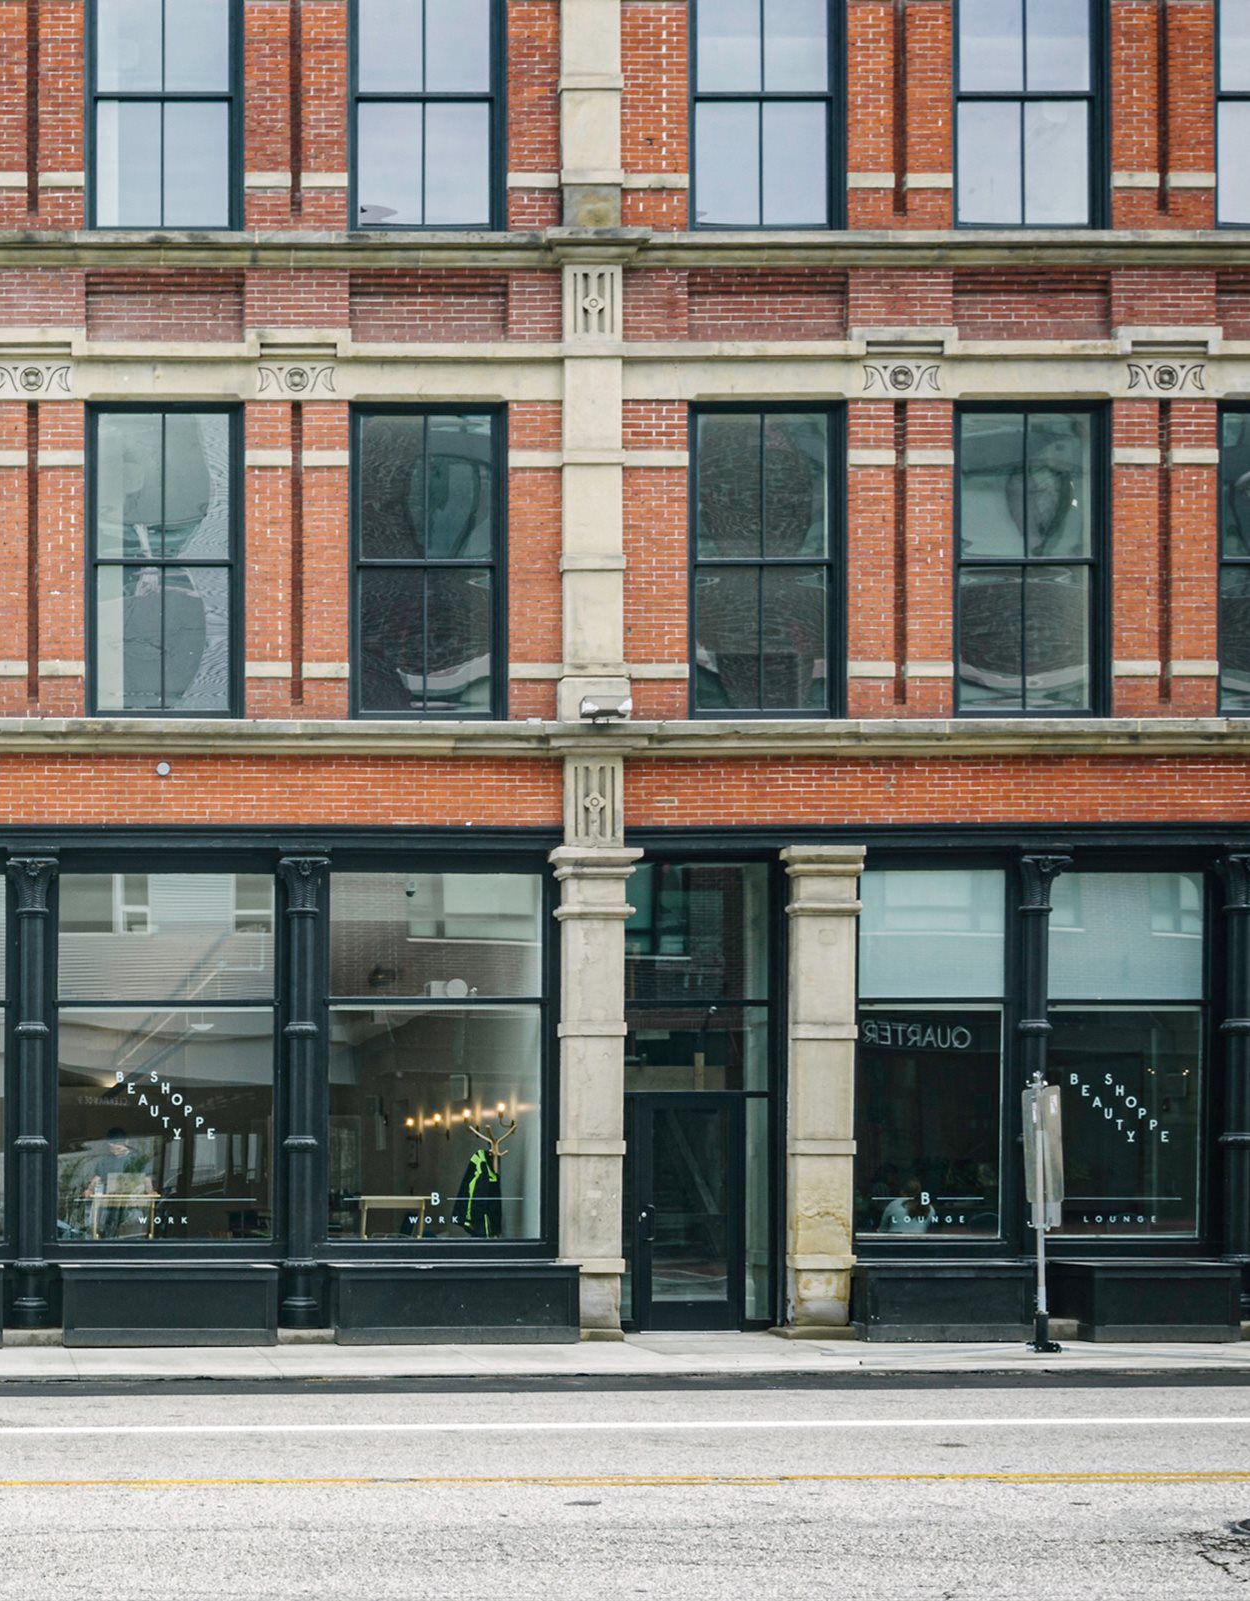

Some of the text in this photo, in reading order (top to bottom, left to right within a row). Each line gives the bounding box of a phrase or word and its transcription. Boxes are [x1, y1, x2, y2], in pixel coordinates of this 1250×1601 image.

[116, 1071, 182, 1140] BEAUTY
[150, 1071, 216, 1140] SHOPPE
[1070, 1073, 1136, 1142] BEAUTY
[1104, 1073, 1169, 1142] SHOPPE
[431, 1192, 440, 1206] B
[920, 1192, 930, 1205] B
[1083, 1215, 1157, 1223] LOUNGE
[409, 1216, 458, 1224] WORK
